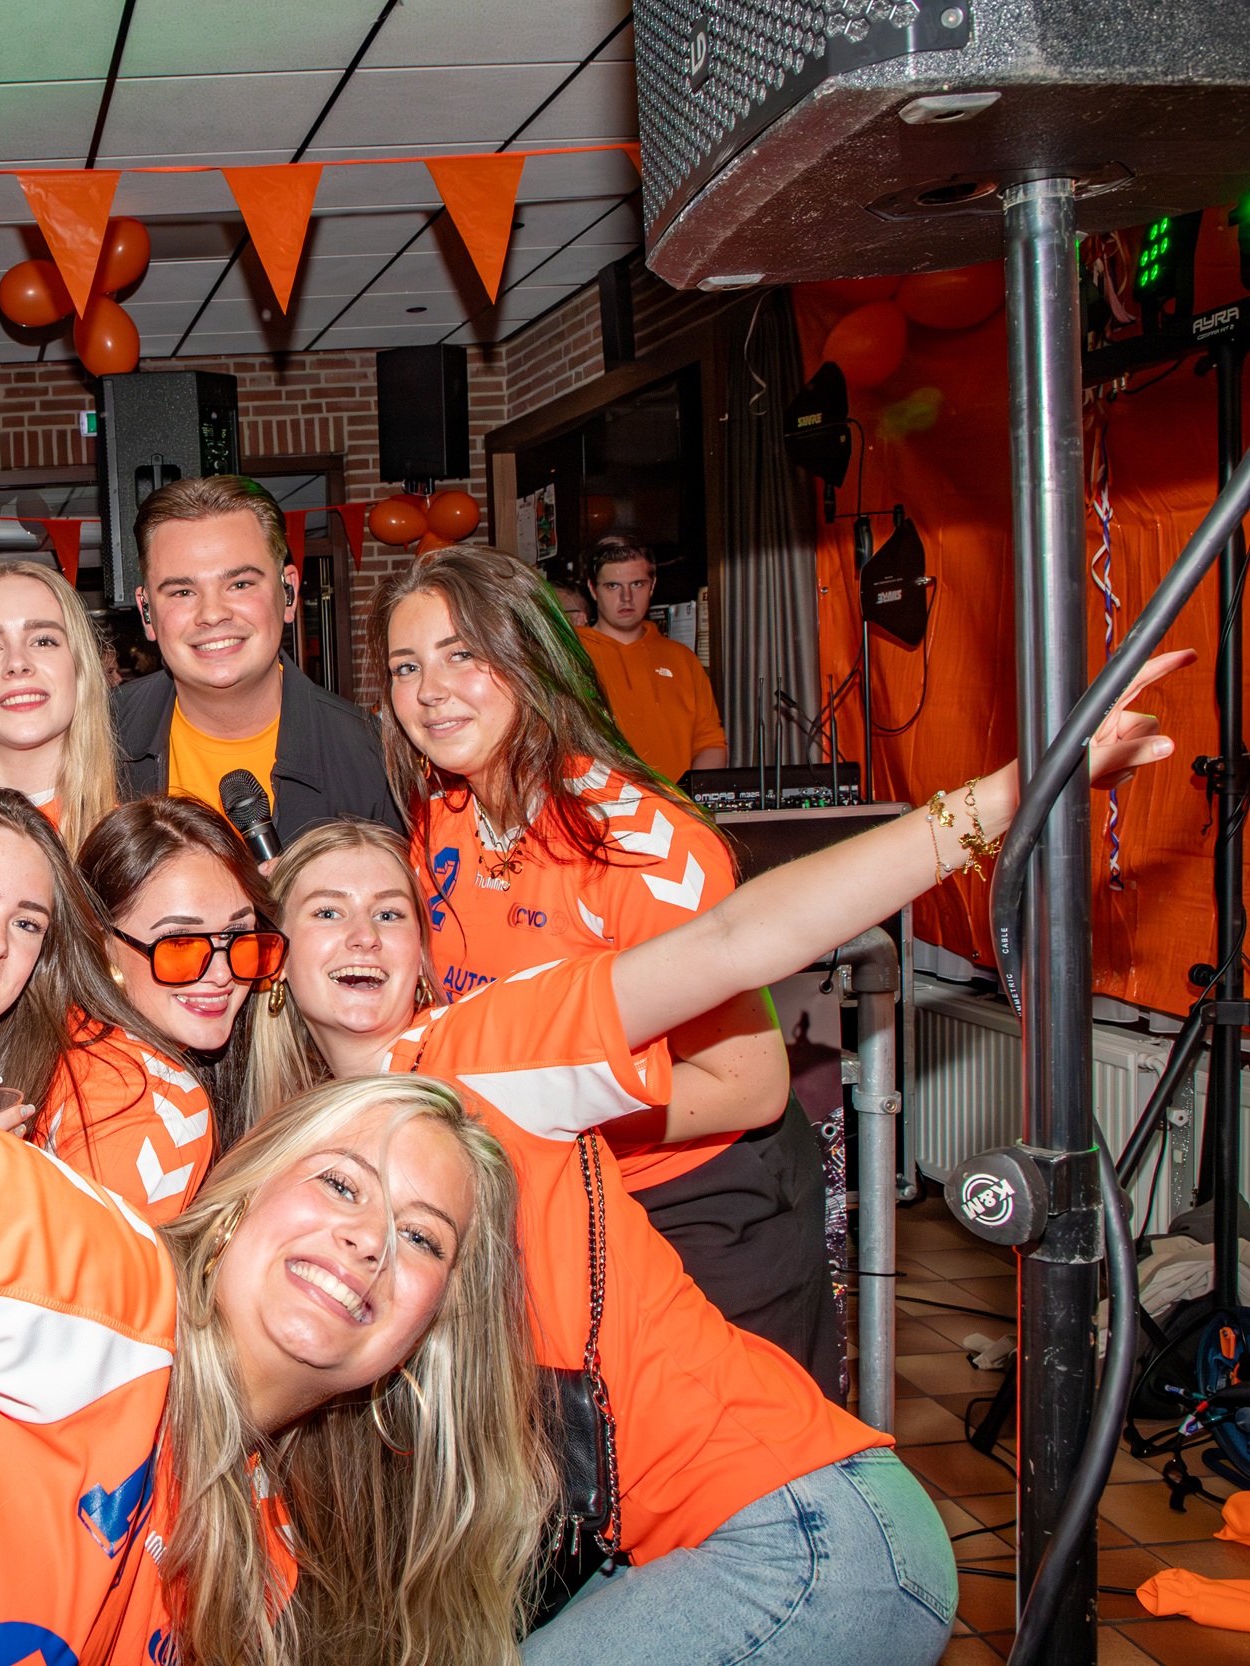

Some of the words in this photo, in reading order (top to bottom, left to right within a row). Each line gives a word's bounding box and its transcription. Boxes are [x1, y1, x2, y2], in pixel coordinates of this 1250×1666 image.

[691, 31, 707, 76] LD
[1192, 306, 1240, 334] AYRA
[701, 792, 735, 801] MIDAS
[514, 907, 548, 928] CVO
[1000, 927, 1010, 955] CABLE
[443, 965, 498, 992] AUT
[961, 1178, 1017, 1220] K&M
